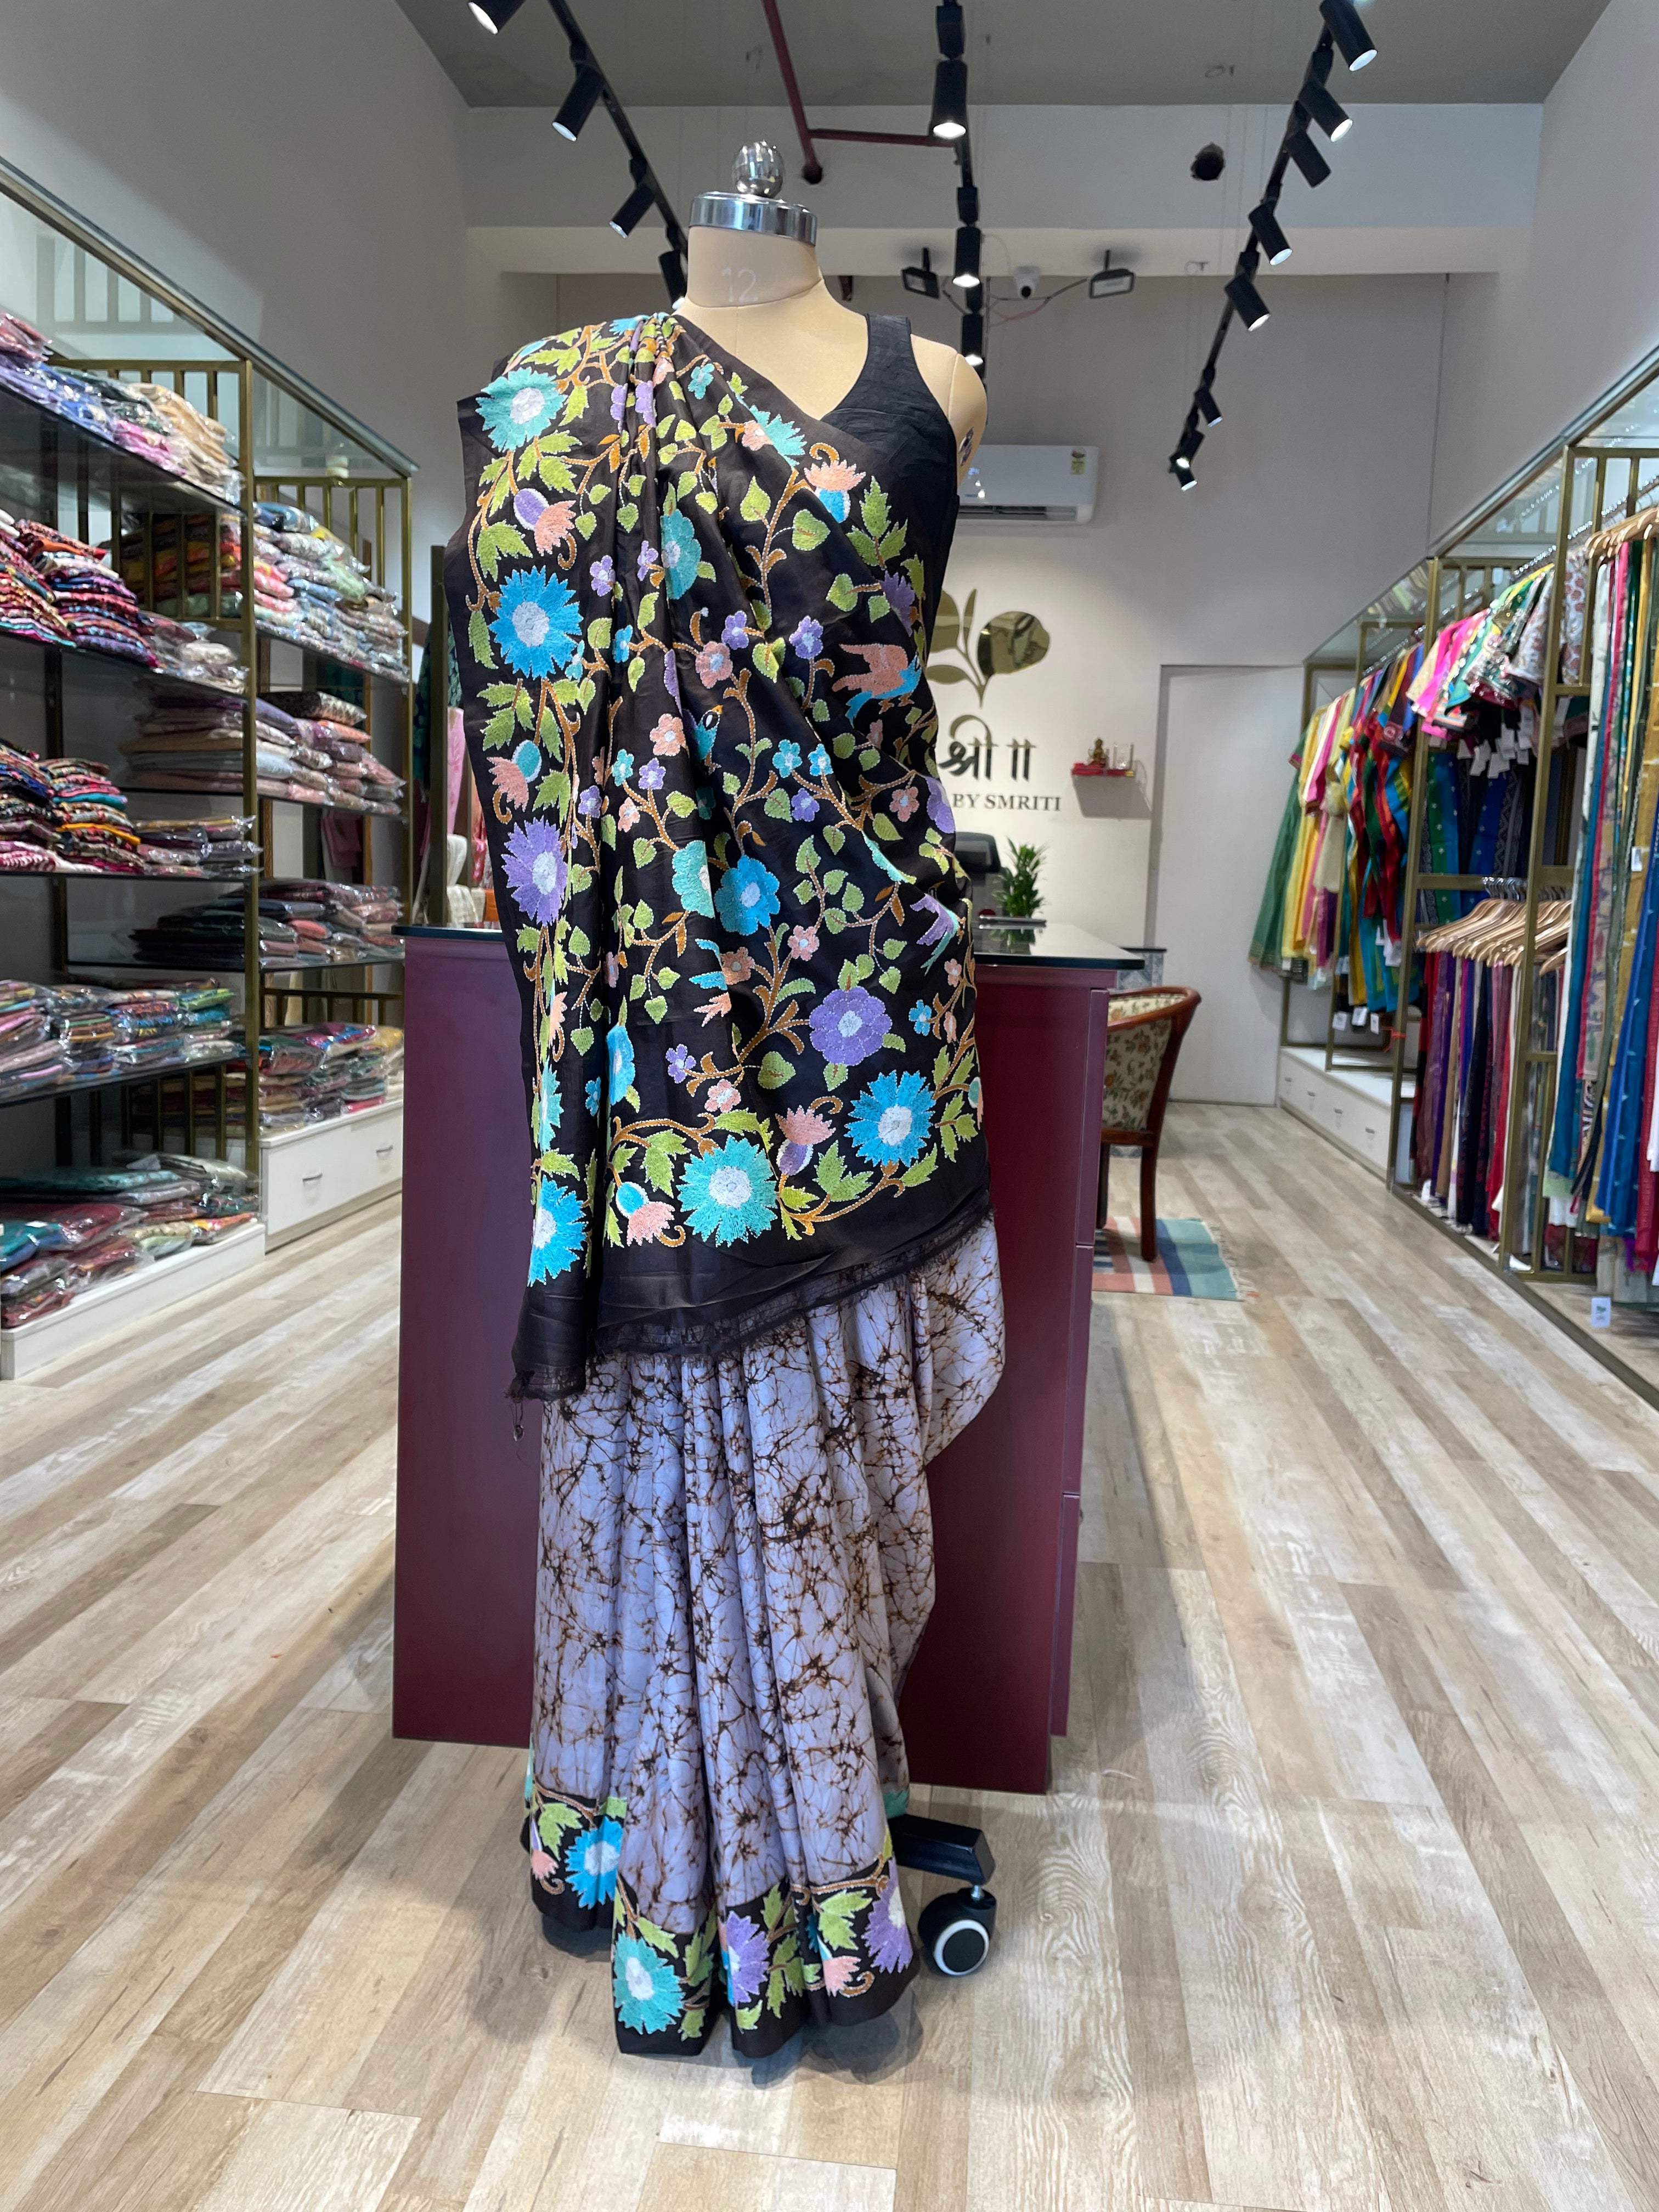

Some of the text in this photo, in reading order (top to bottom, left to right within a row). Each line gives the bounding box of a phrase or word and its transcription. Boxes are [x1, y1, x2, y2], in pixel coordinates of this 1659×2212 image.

[721, 267, 758, 302] 12
[952, 794, 1062, 811] BY SMRITI
